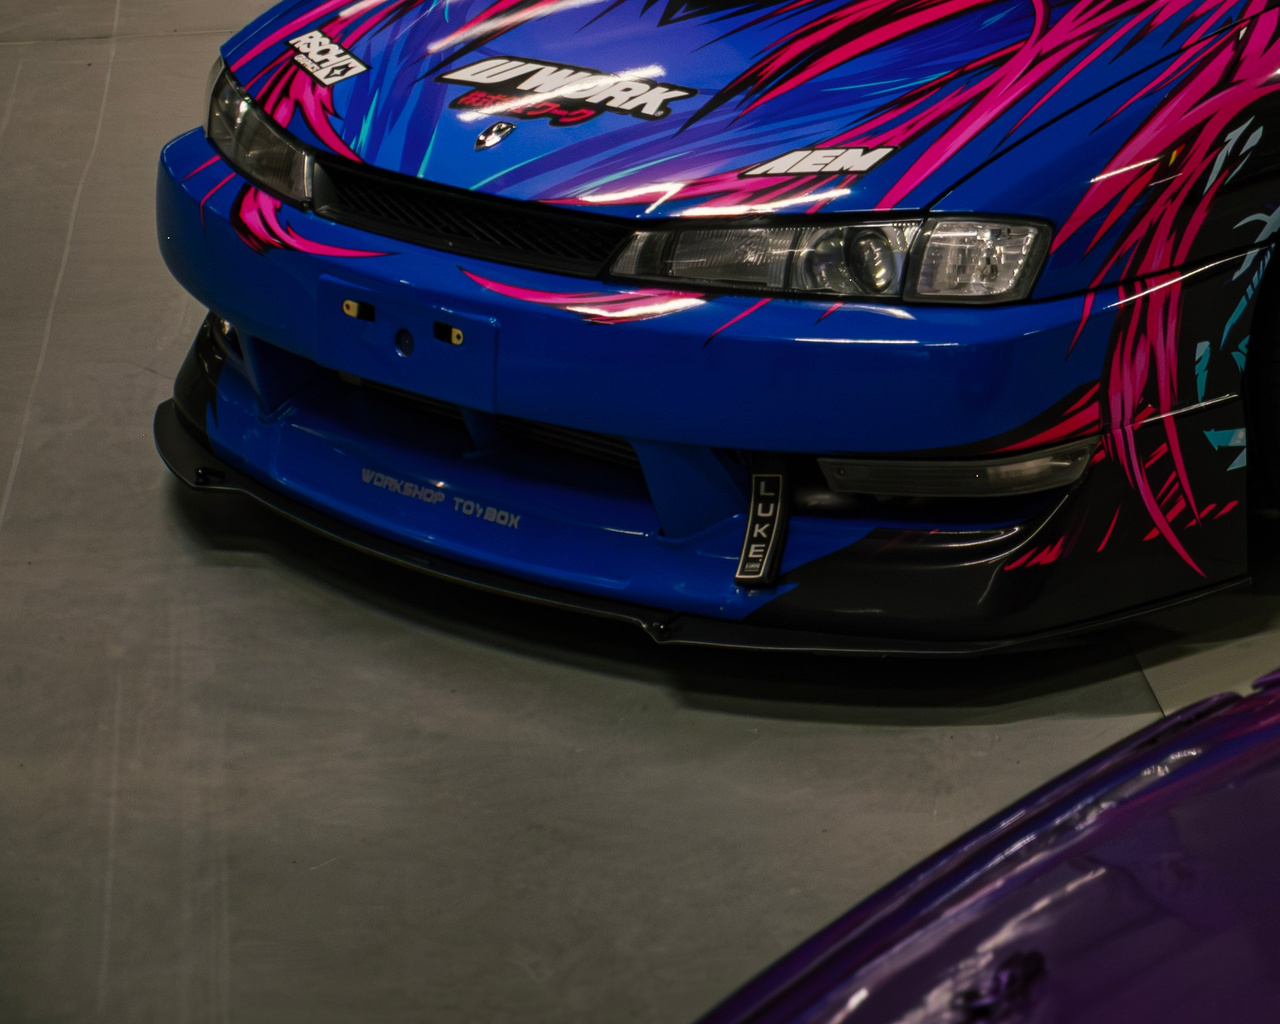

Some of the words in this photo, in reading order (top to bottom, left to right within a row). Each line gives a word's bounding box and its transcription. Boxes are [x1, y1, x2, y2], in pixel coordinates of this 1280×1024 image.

[288, 30, 352, 69] RSCH
[515, 62, 690, 116] WORK
[744, 147, 895, 175] AEM
[361, 466, 446, 505] WORKSHOP
[747, 481, 776, 559] LUKE
